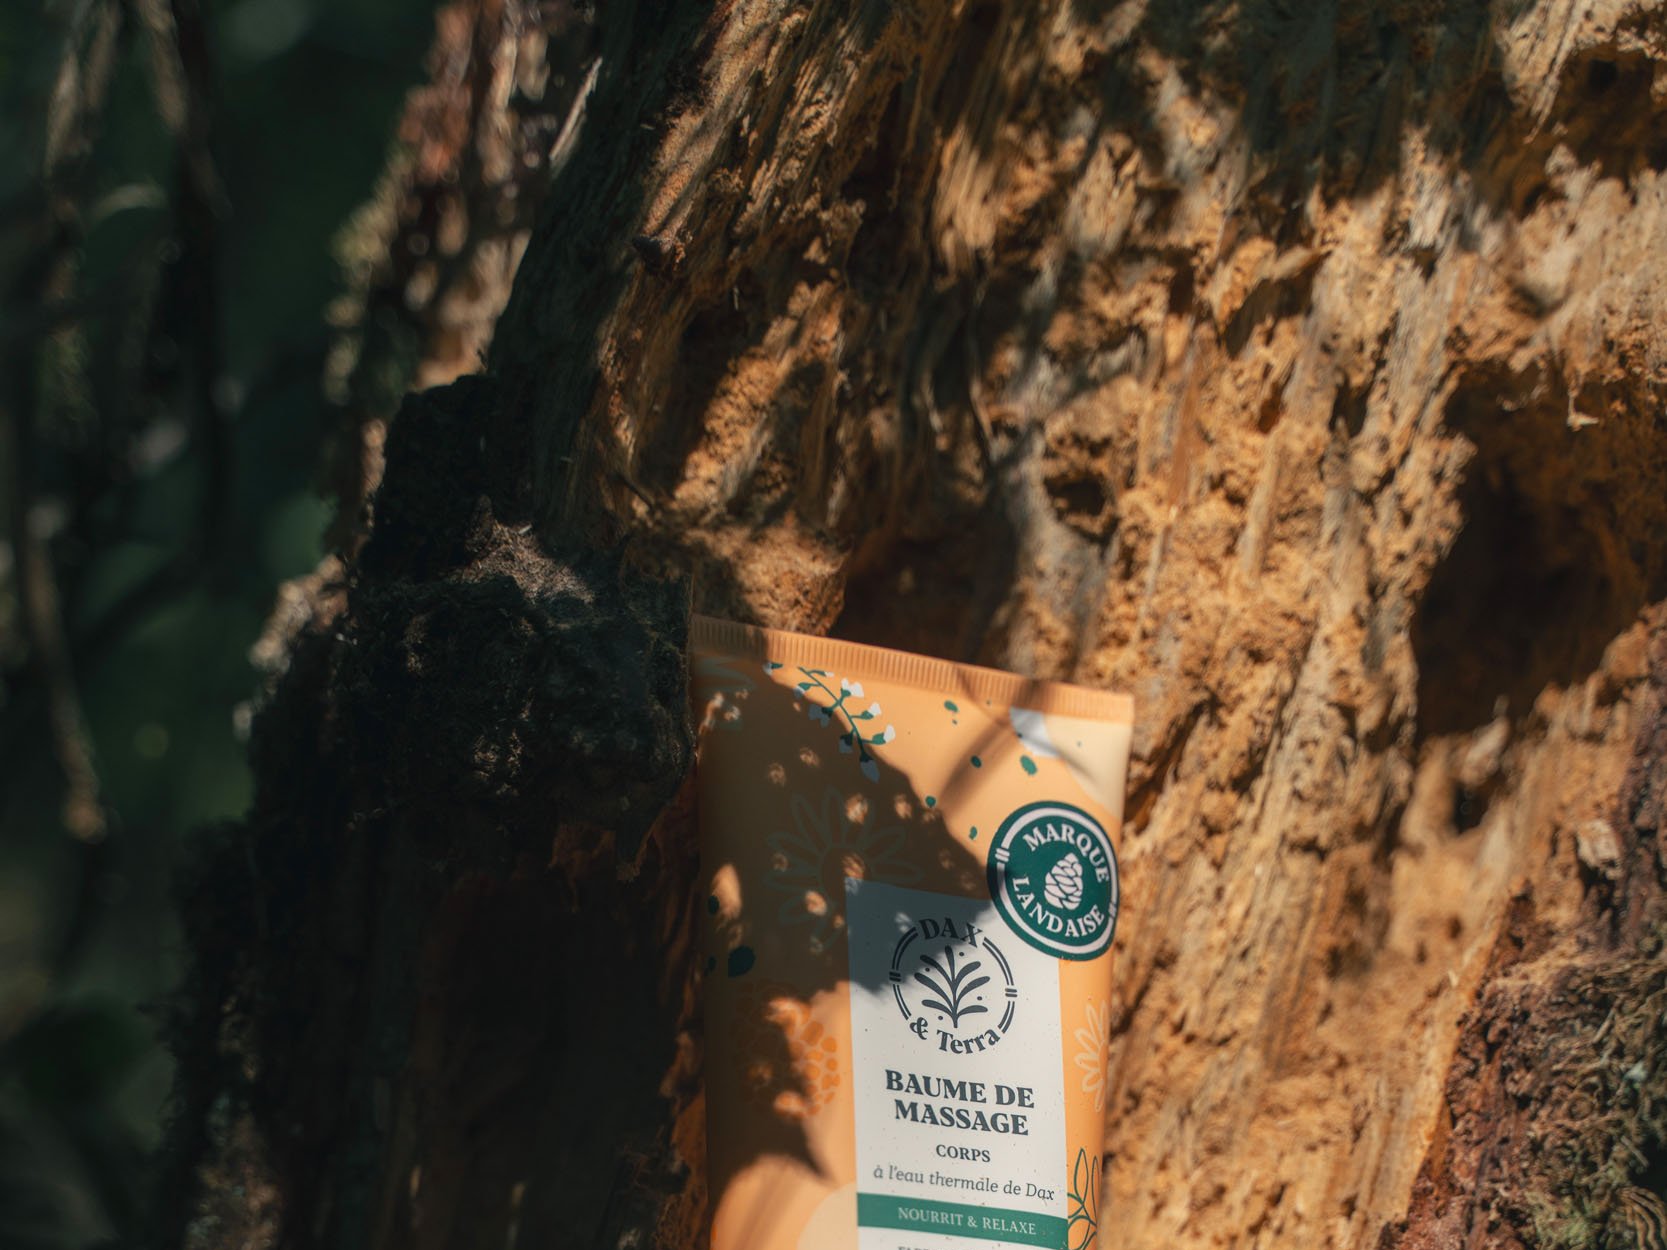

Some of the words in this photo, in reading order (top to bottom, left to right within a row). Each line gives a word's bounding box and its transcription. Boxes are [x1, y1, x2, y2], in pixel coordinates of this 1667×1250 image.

[1023, 823, 1109, 883] MARQUE
[1012, 875, 1105, 937] LANDAISE
[919, 917, 983, 948] DAX
[909, 1016, 929, 1040] &
[936, 1028, 1000, 1054] Terra
[885, 1069, 987, 1104] BAUME
[994, 1084, 1035, 1109] DE
[894, 1099, 1029, 1136] MASSAGE
[935, 1144, 991, 1163] CORPS
[873, 1165, 884, 1179] à
[889, 1165, 924, 1184] l'eau
[929, 1171, 999, 1193] thermale
[1003, 1180, 1021, 1196] de
[1025, 1183, 1055, 1200] Dax
[897, 1207, 963, 1226] NOURRIT
[967, 1216, 978, 1228] &
[983, 1218, 1036, 1235] RELAXE
